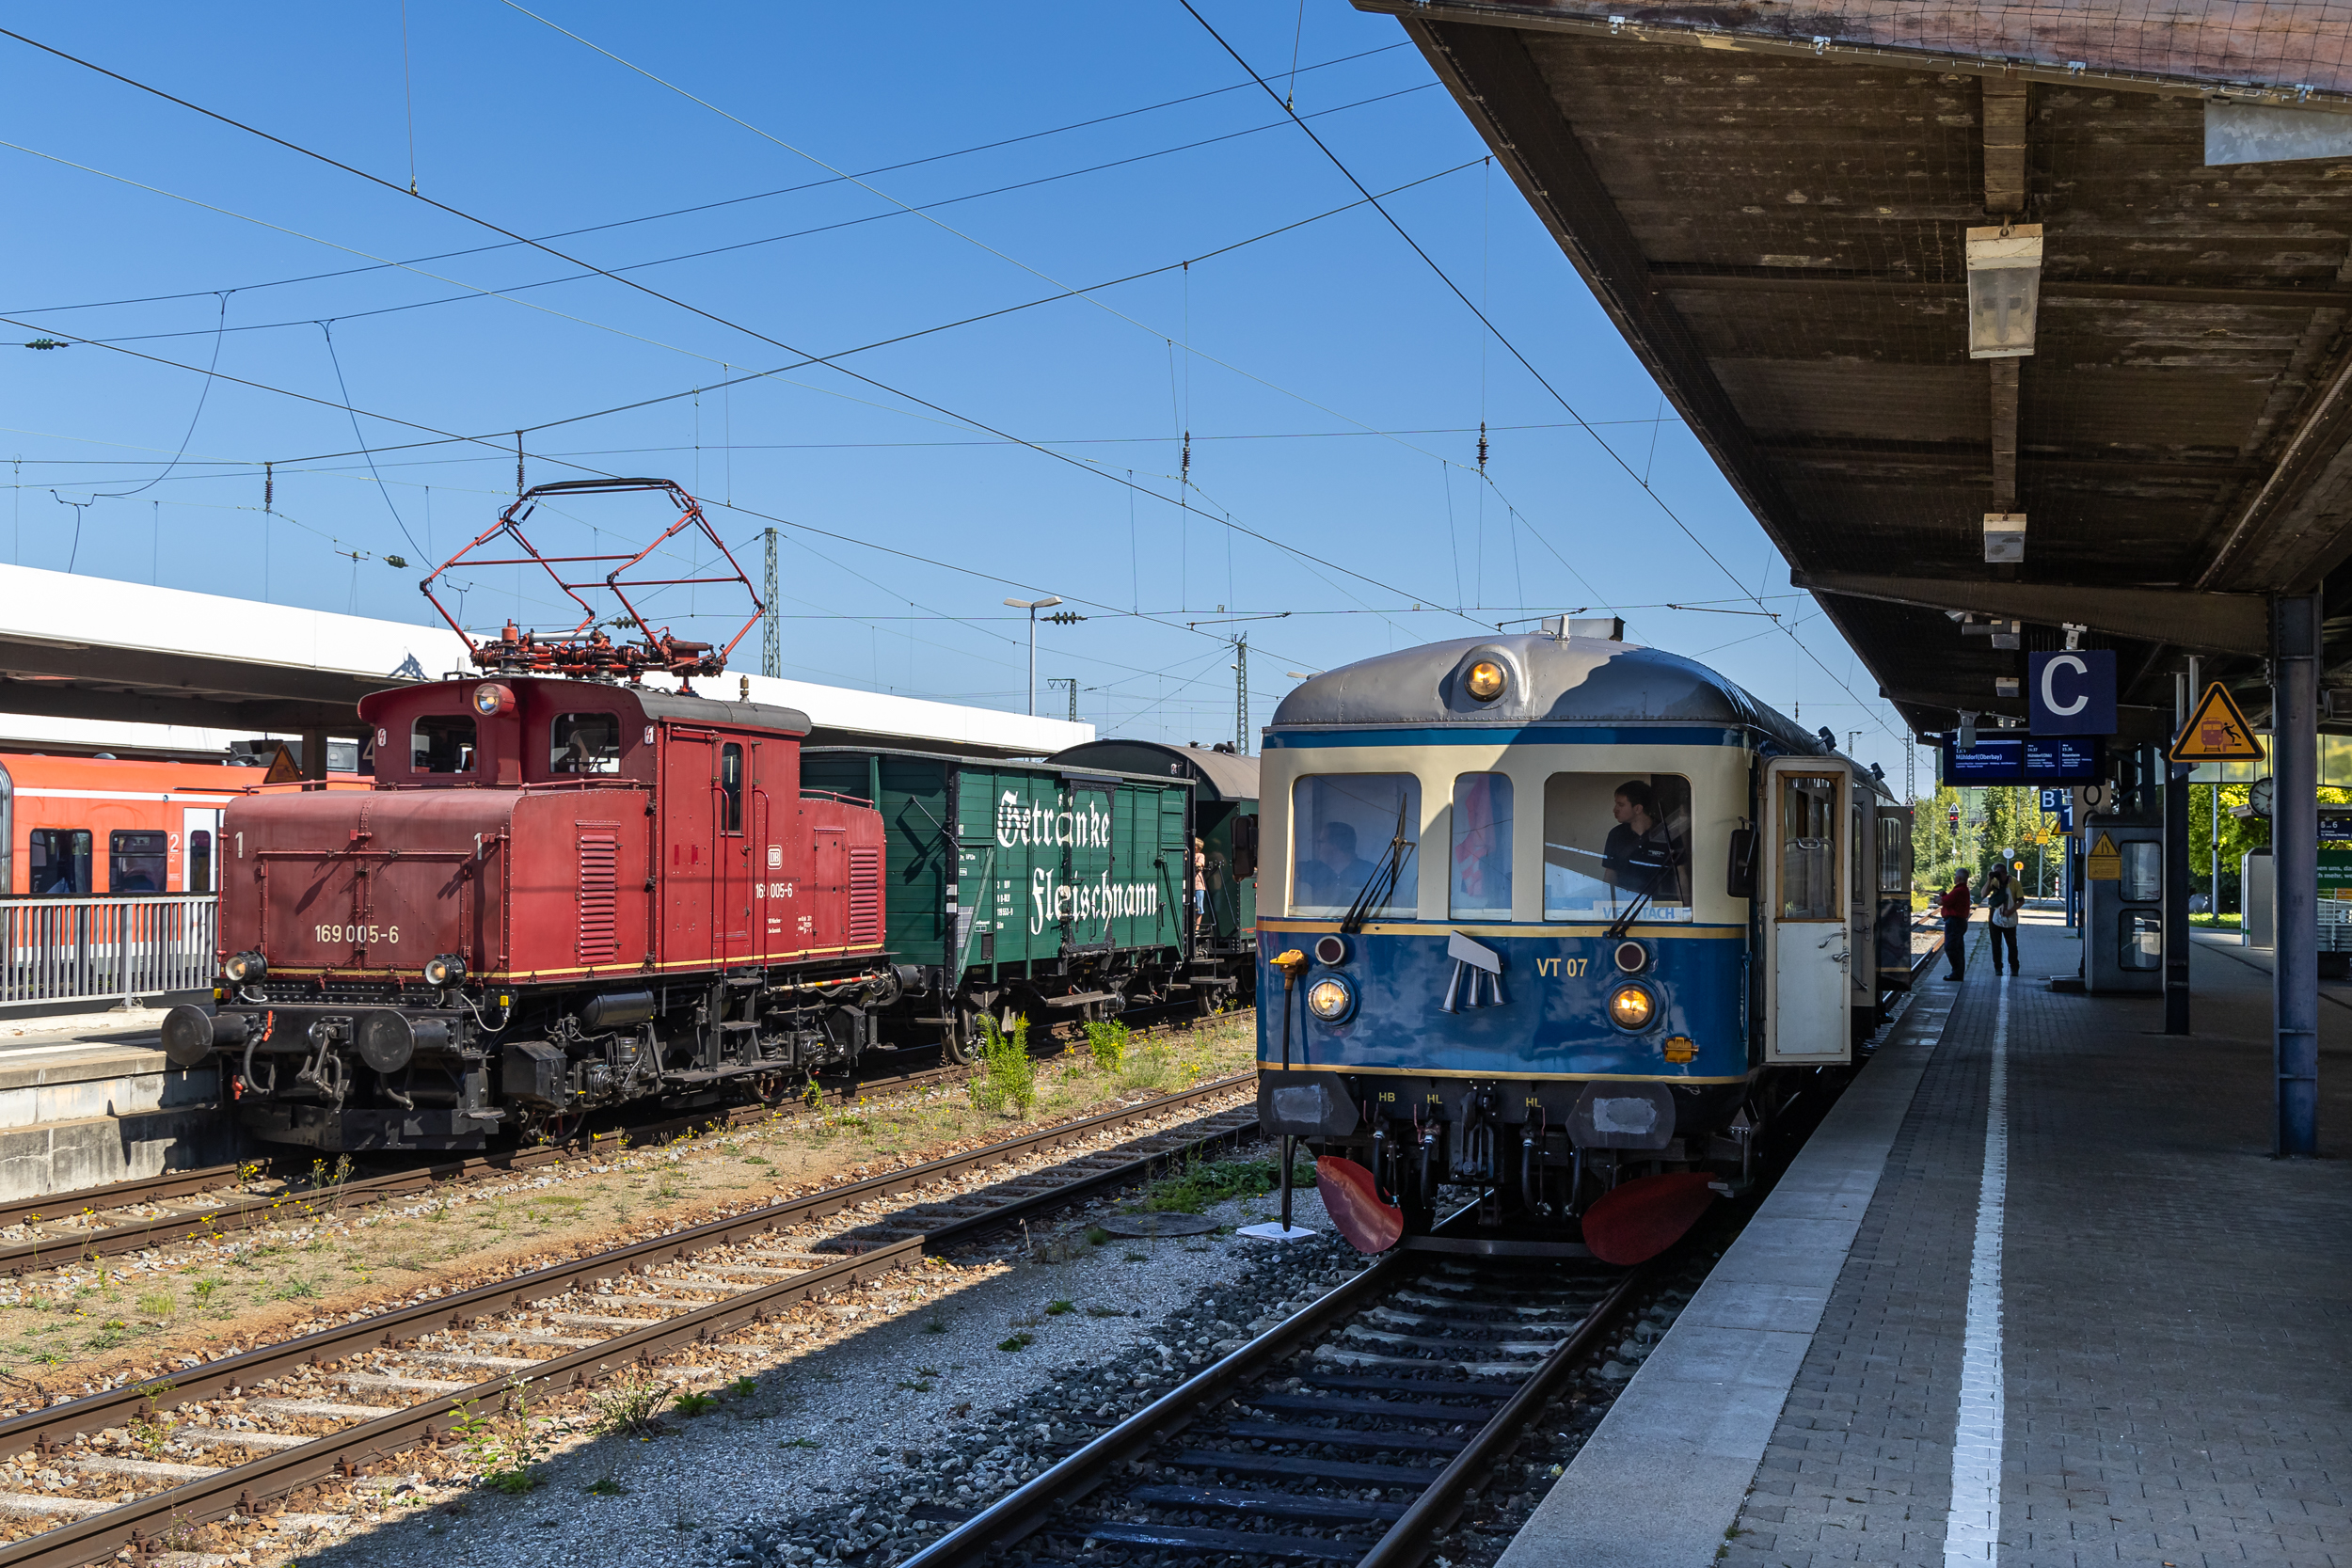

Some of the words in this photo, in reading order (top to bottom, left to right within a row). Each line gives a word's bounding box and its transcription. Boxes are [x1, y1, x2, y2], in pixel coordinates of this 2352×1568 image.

[2042, 655, 2089, 716] C
[362, 736, 375, 767] 4
[2042, 791, 2055, 807] B
[997, 790, 1110, 847] Getränke
[2064, 806, 2073, 826] 1
[169, 833, 180, 852] 2
[235, 832, 244, 858] 1
[474, 832, 482, 860] 1
[771, 882, 793, 898] 005-6
[1031, 867, 1157, 935] Fleischmann
[1603, 907, 1675, 919] VIETACH
[315, 925, 342, 942] 169
[346, 925, 399, 943] 005-6
[1536, 958, 1561, 977] VT
[1566, 958, 1588, 977] 07
[1378, 1092, 1395, 1101] HB
[1427, 1094, 1442, 1104] HL
[1526, 1098, 1542, 1108] HL
